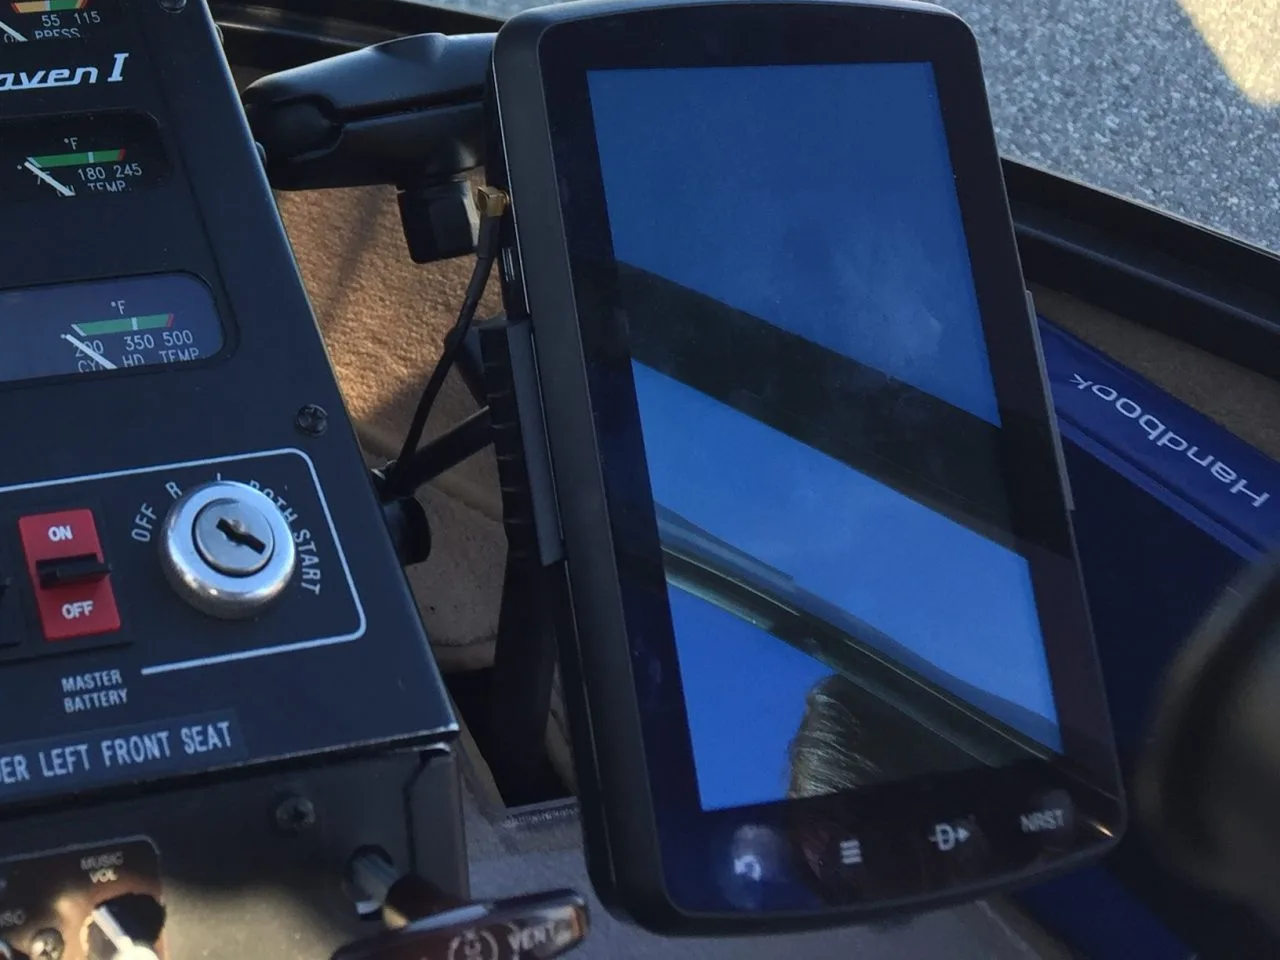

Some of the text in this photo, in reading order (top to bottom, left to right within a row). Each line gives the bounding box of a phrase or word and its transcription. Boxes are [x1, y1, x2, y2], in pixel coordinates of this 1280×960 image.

[42, 14, 60, 27] 55
[107, 52, 129, 82] I
[124, 334, 154, 351] 350
[162, 330, 193, 346] 500
[1070, 373, 1270, 508] Handbook
[47, 525, 73, 542] ON
[131, 503, 157, 542] OFF
[293, 529, 320, 595] START
[62, 600, 94, 620] OFF
[61, 669, 122, 692] MASTER
[64, 688, 128, 713] BATTERY
[38, 744, 90, 777] LEFT
[100, 730, 171, 768] FRONT
[180, 721, 232, 754] SEAT
[1020, 809, 1064, 833] NRST
[80, 852, 124, 870] MUSIC
[88, 868, 119, 884] VOL
